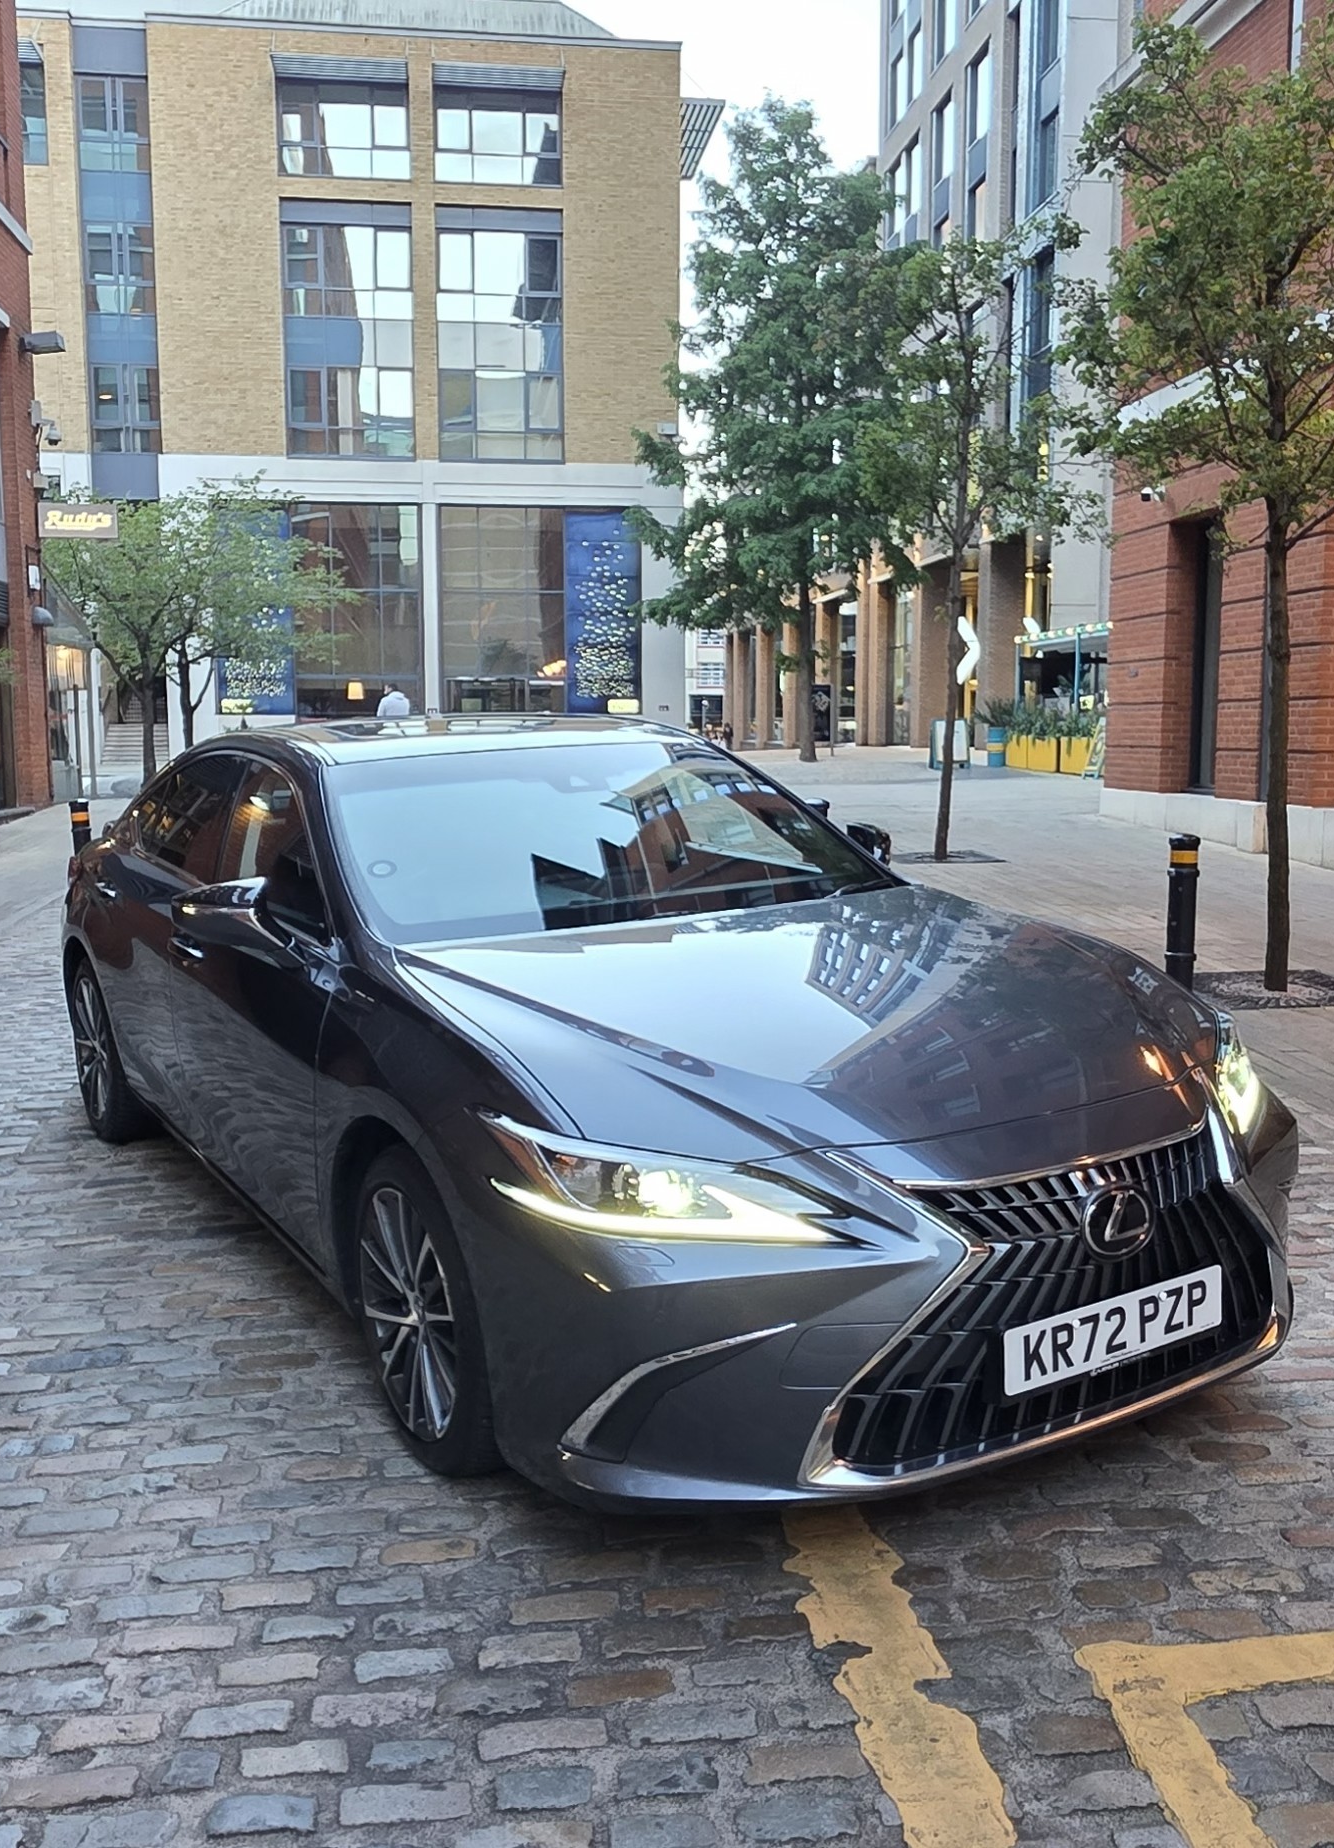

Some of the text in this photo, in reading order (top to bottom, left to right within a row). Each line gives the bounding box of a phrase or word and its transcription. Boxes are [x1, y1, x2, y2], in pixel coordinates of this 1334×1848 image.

[44, 510, 113, 531] Rudy's
[1023, 1280, 1207, 1382] KR72 PZP
